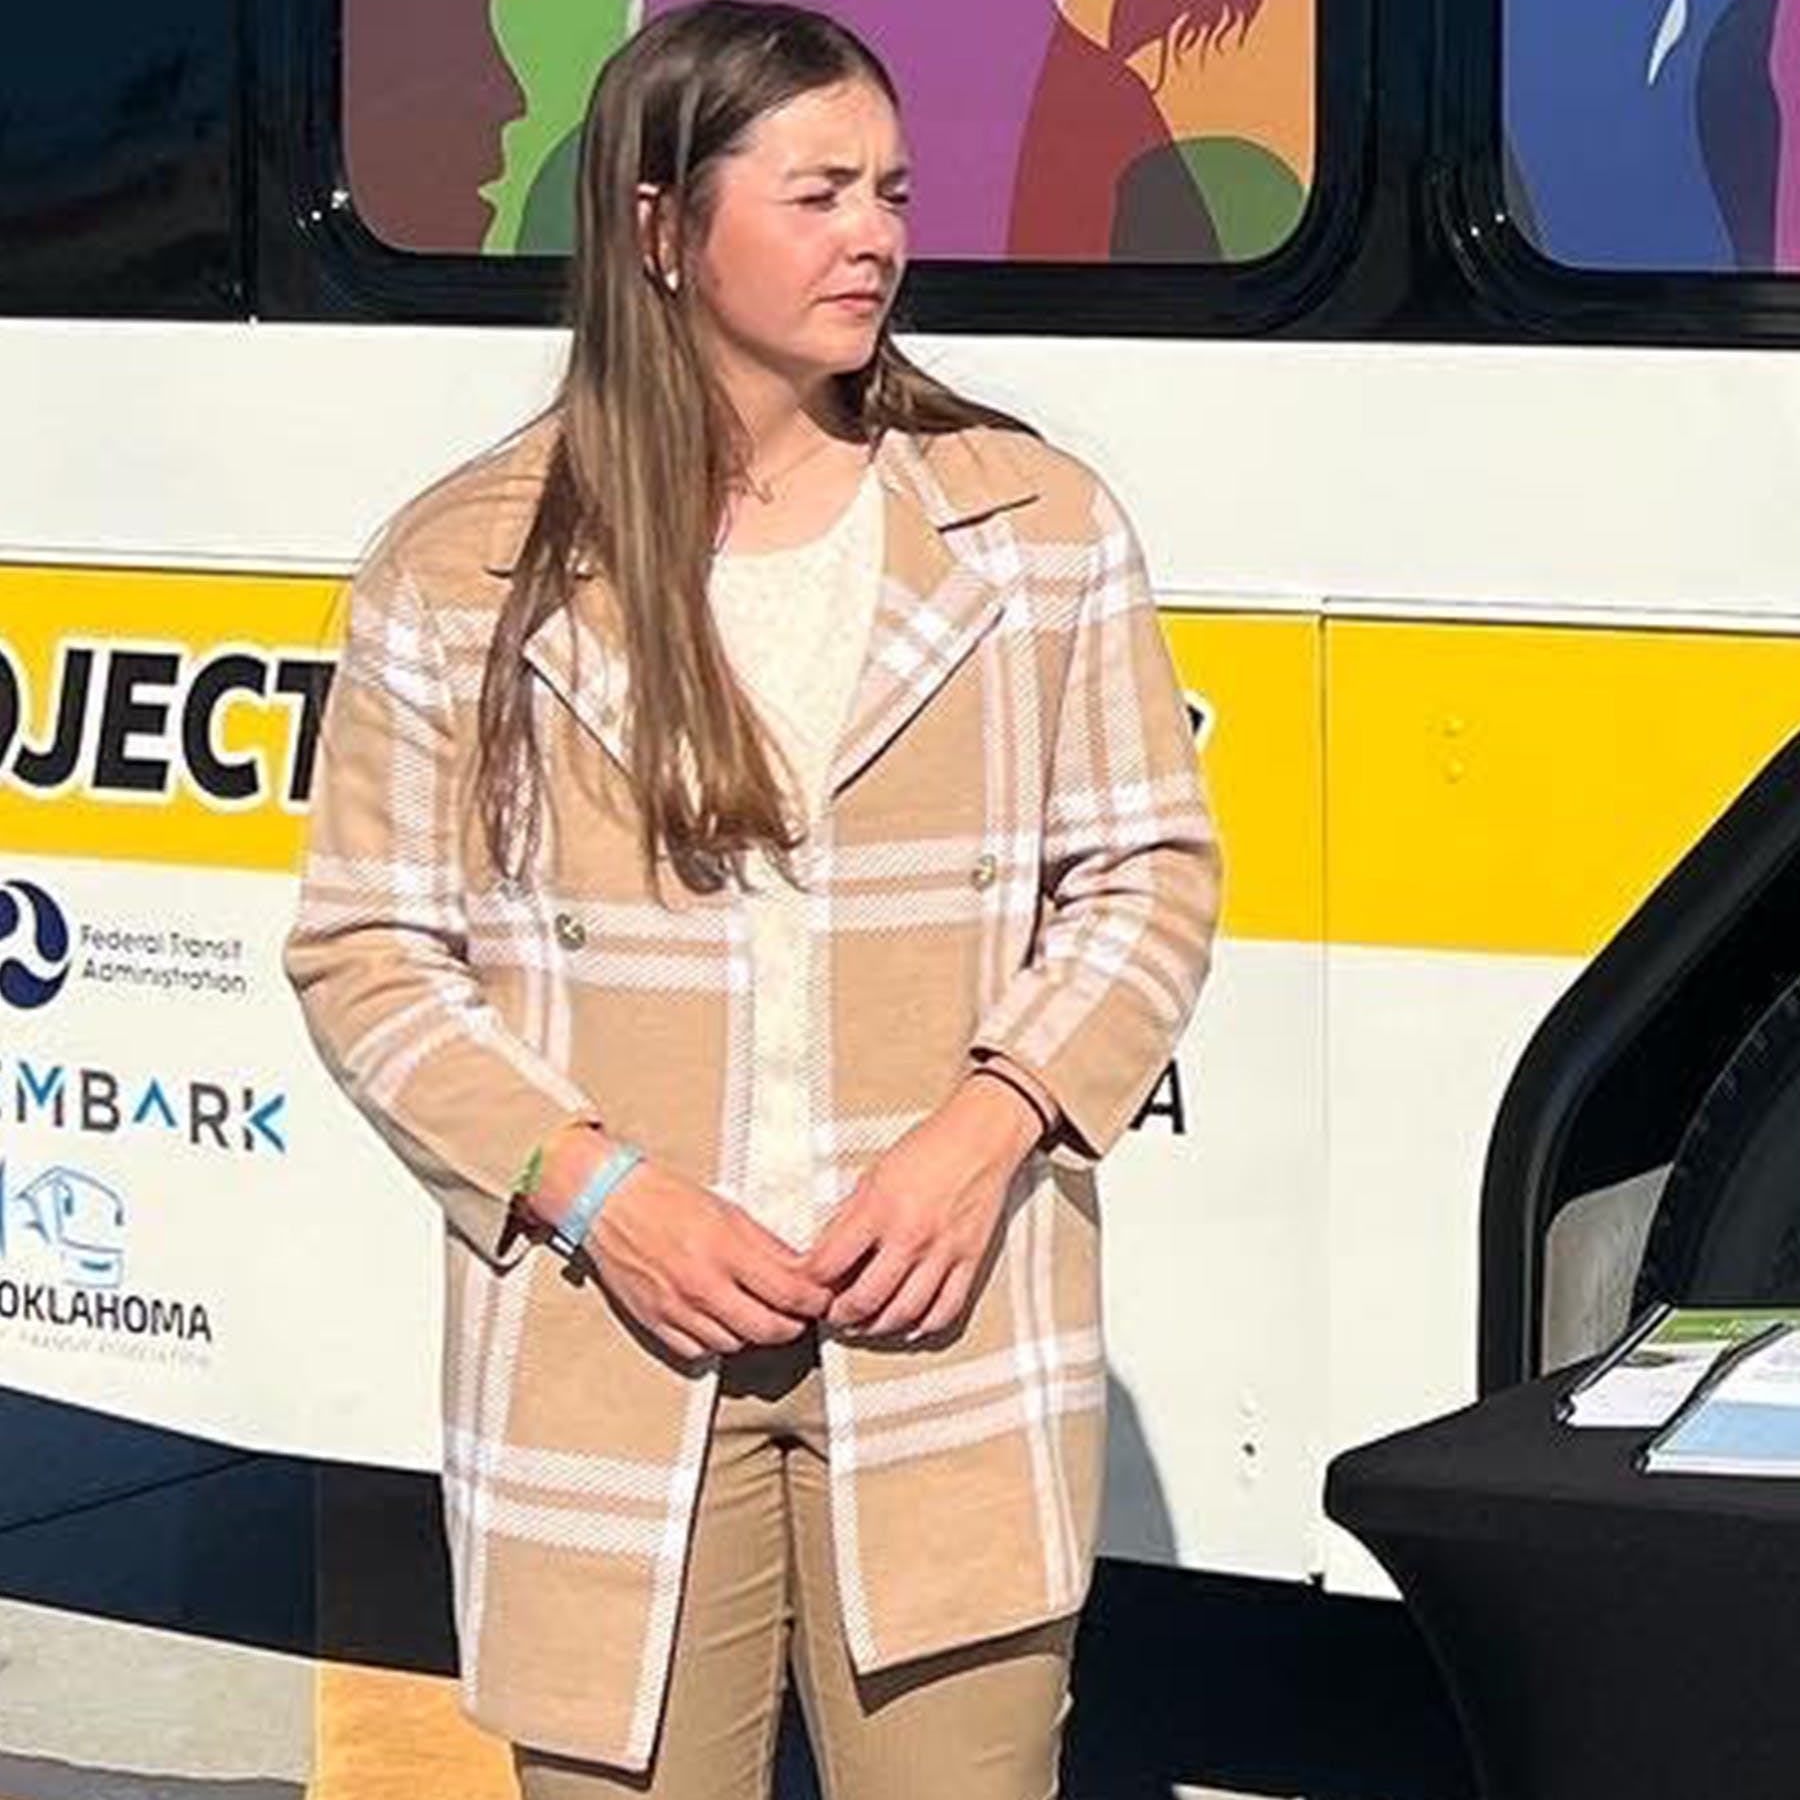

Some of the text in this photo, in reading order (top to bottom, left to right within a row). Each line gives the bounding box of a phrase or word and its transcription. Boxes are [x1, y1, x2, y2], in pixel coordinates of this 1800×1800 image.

[80, 924, 243, 959] Federal Transit
[81, 957, 248, 993] Administration
[0, 1060, 286, 1154] MBARK
[0, 1278, 213, 1342] OKLAHOMA
